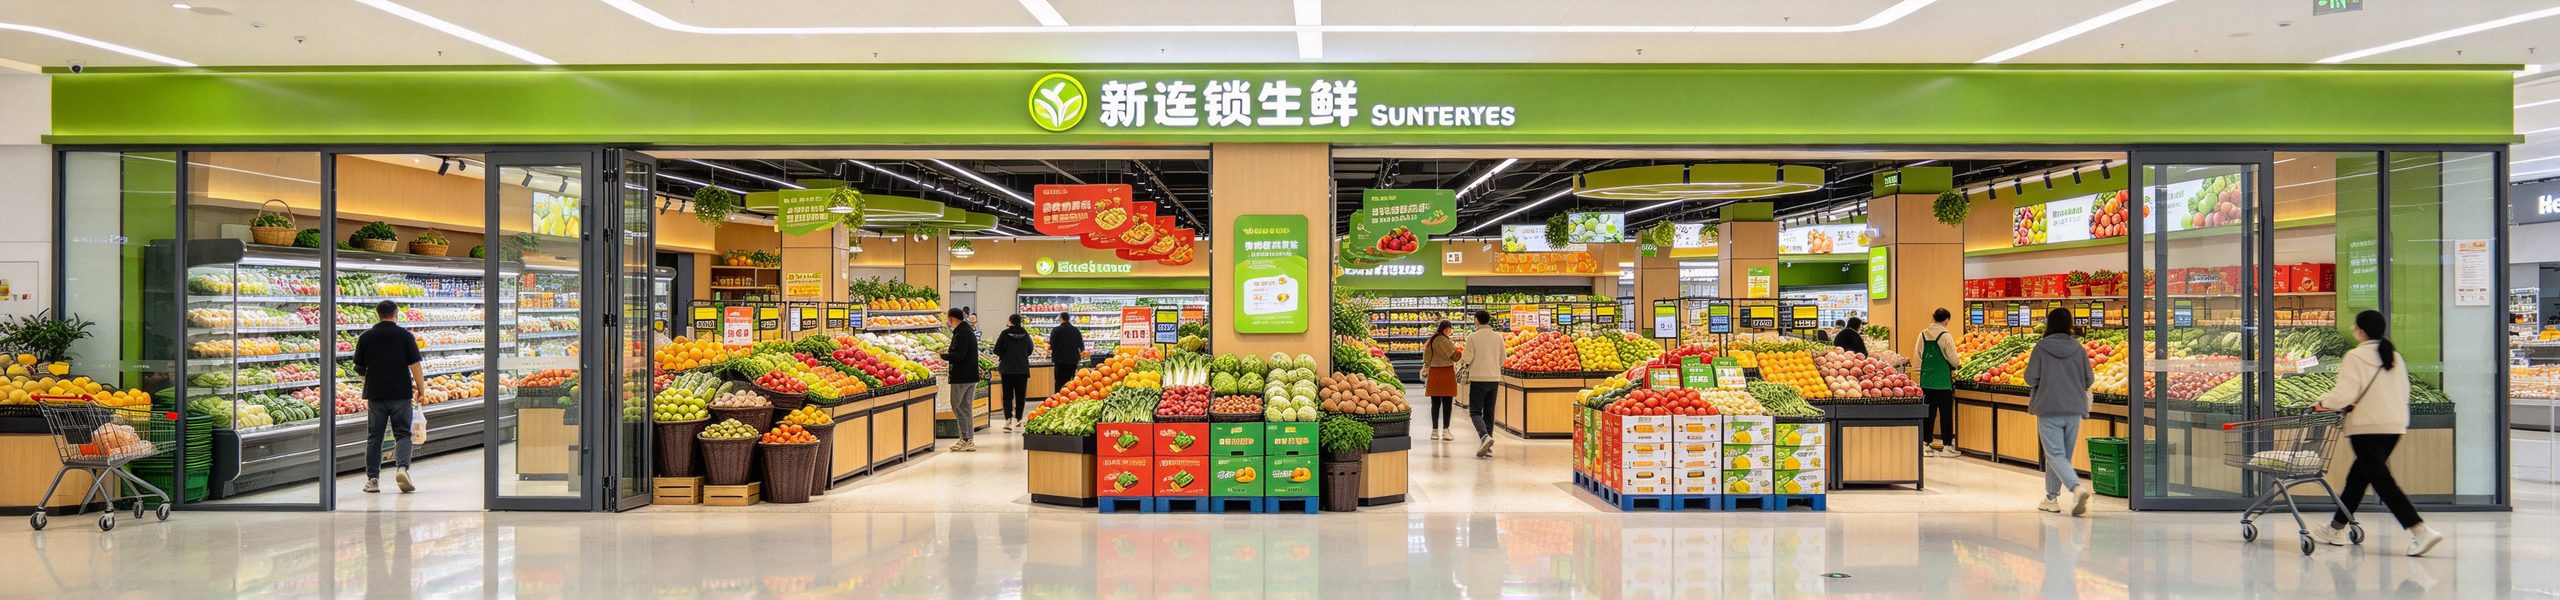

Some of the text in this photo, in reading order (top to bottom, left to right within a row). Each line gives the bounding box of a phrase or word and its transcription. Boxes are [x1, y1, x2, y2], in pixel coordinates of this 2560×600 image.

[1100, 79, 1358, 128] 新连锁生鲜
[1371, 104, 1516, 127] SUNTERYES
